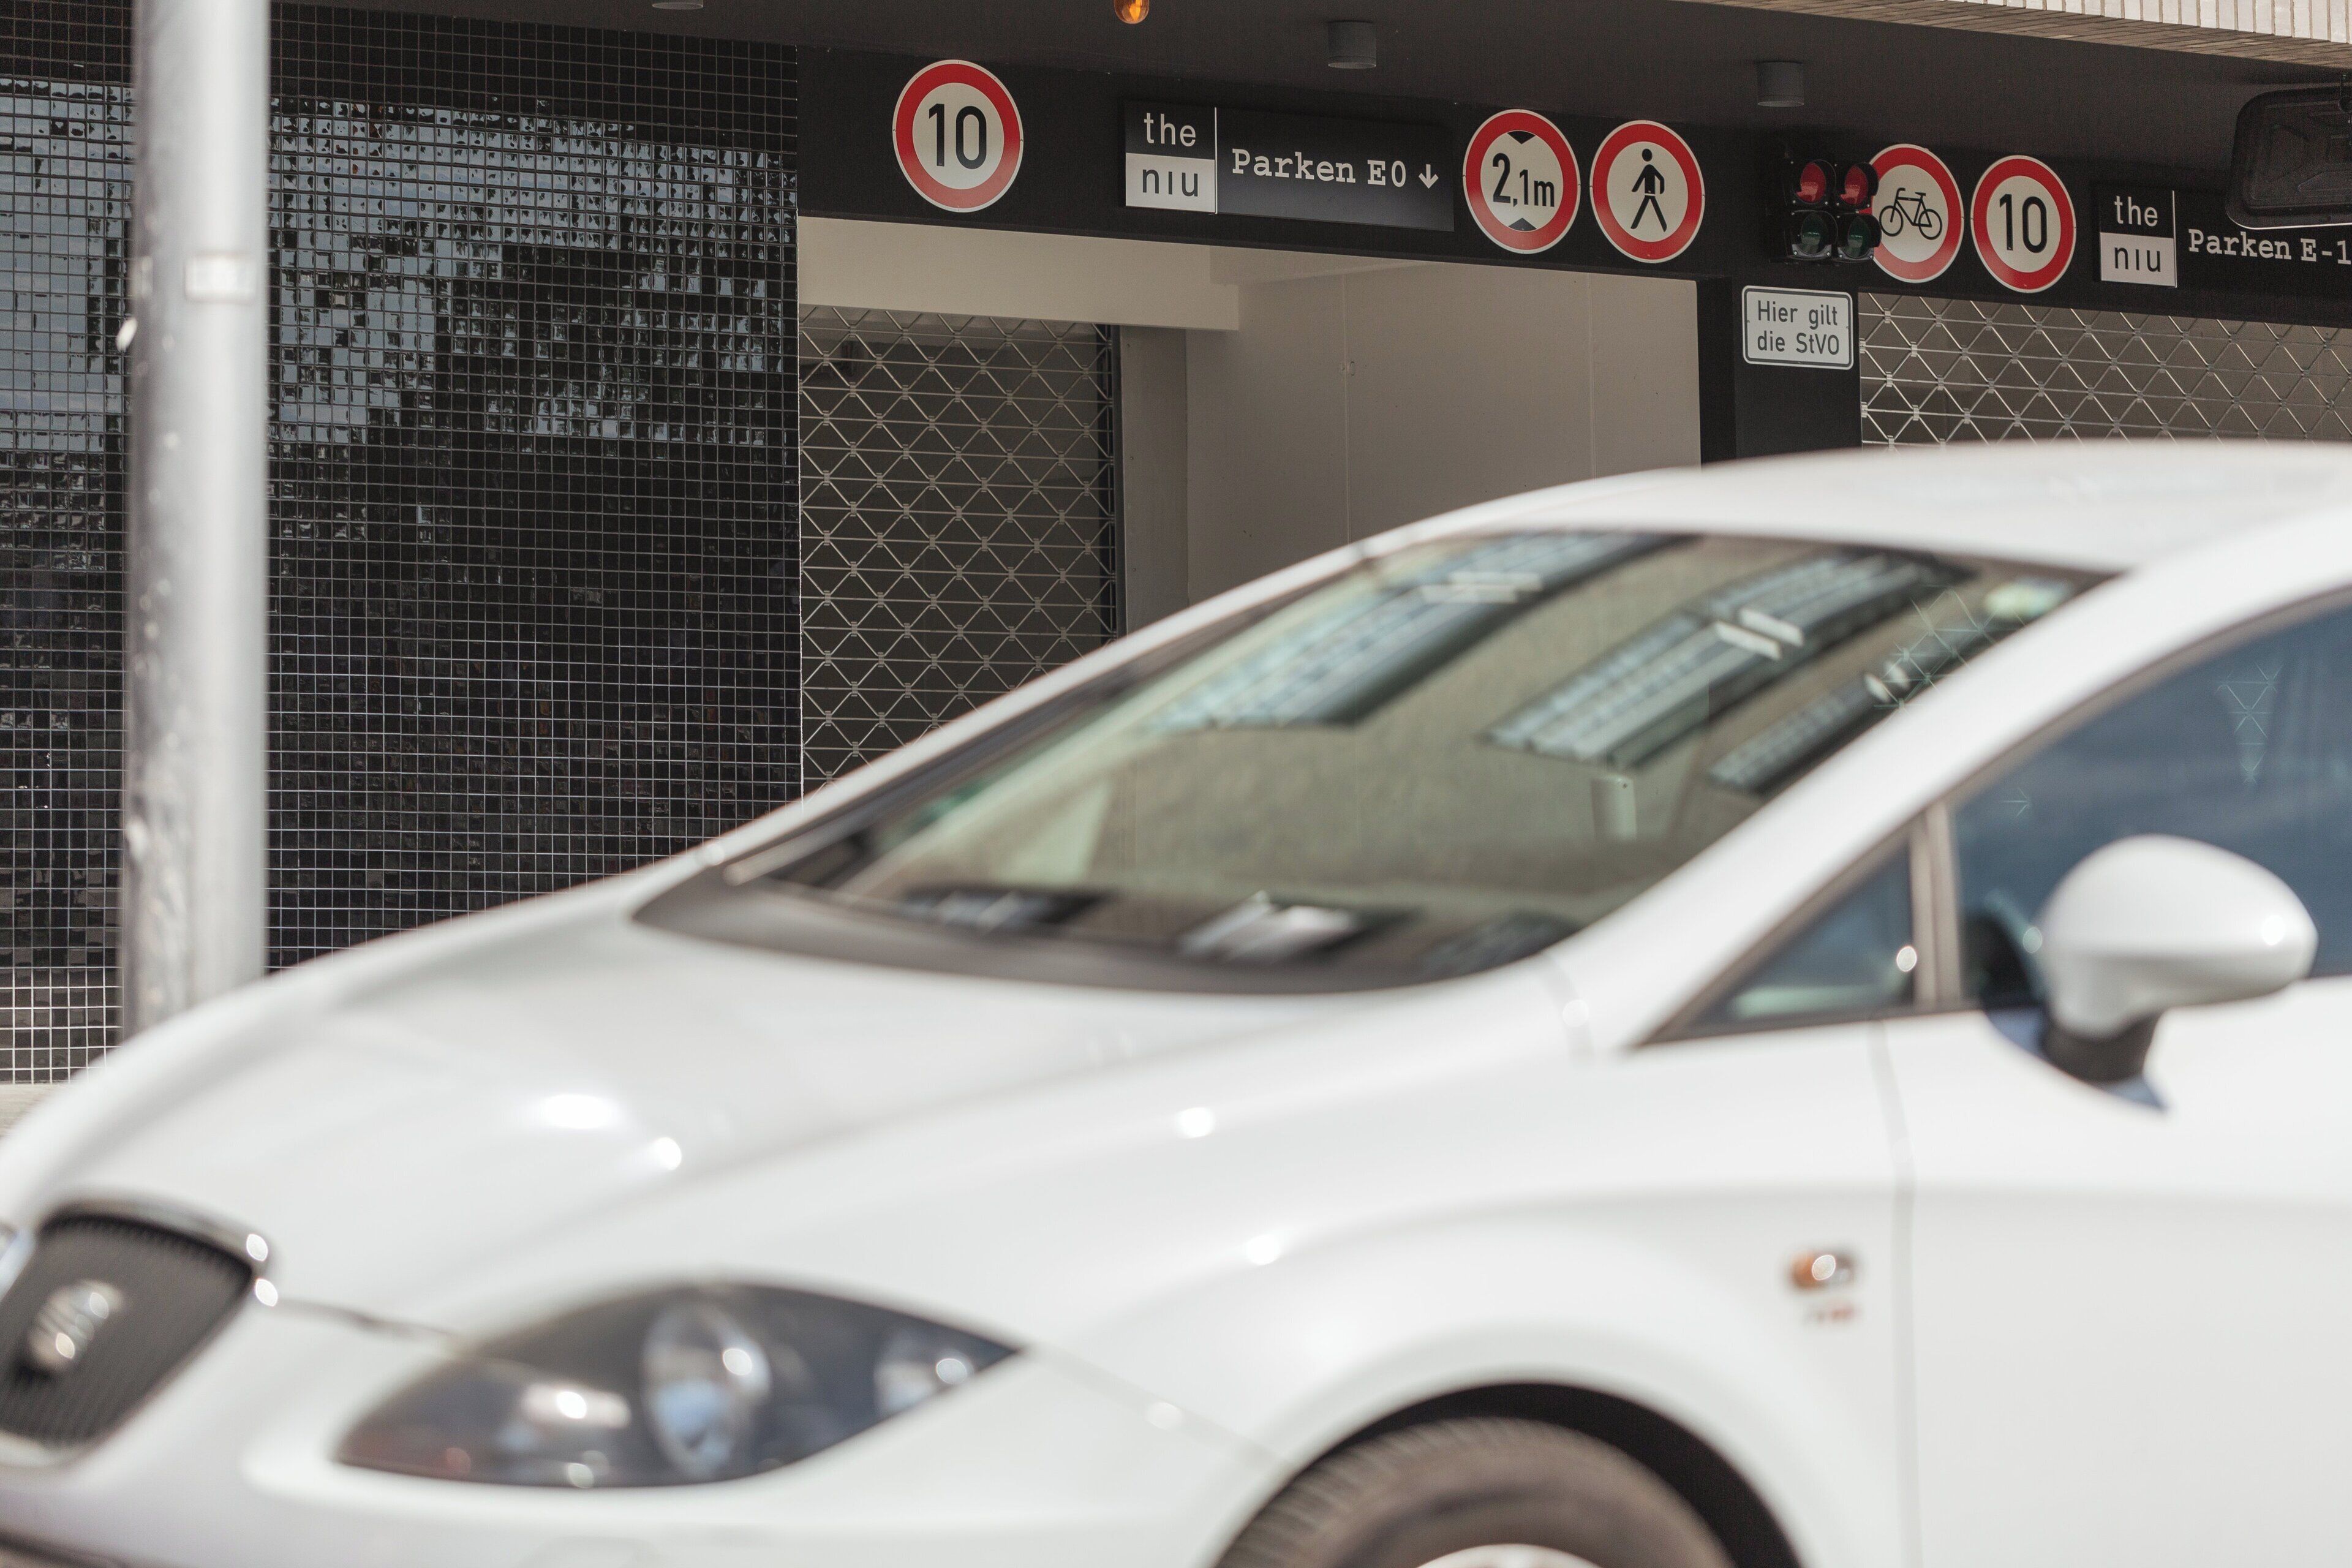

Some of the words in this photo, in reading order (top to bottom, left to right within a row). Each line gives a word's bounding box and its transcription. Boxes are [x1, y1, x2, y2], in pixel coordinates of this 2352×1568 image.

[929, 103, 987, 170] 10
[1144, 113, 1196, 147] the
[1142, 169, 1198, 197] niu
[1232, 148, 1356, 183] Parken
[1367, 159, 1406, 187] E0
[1999, 194, 2048, 254] 10
[2114, 195, 2158, 227] the
[2114, 246, 2161, 273] niu
[2188, 228, 2292, 260] Parken
[2300, 238, 2351, 265] E-1
[1758, 300, 1798, 323] Hier
[1809, 304, 1838, 330] gilt
[1757, 330, 1785, 352] die
[1796, 333, 1839, 355] StVO
